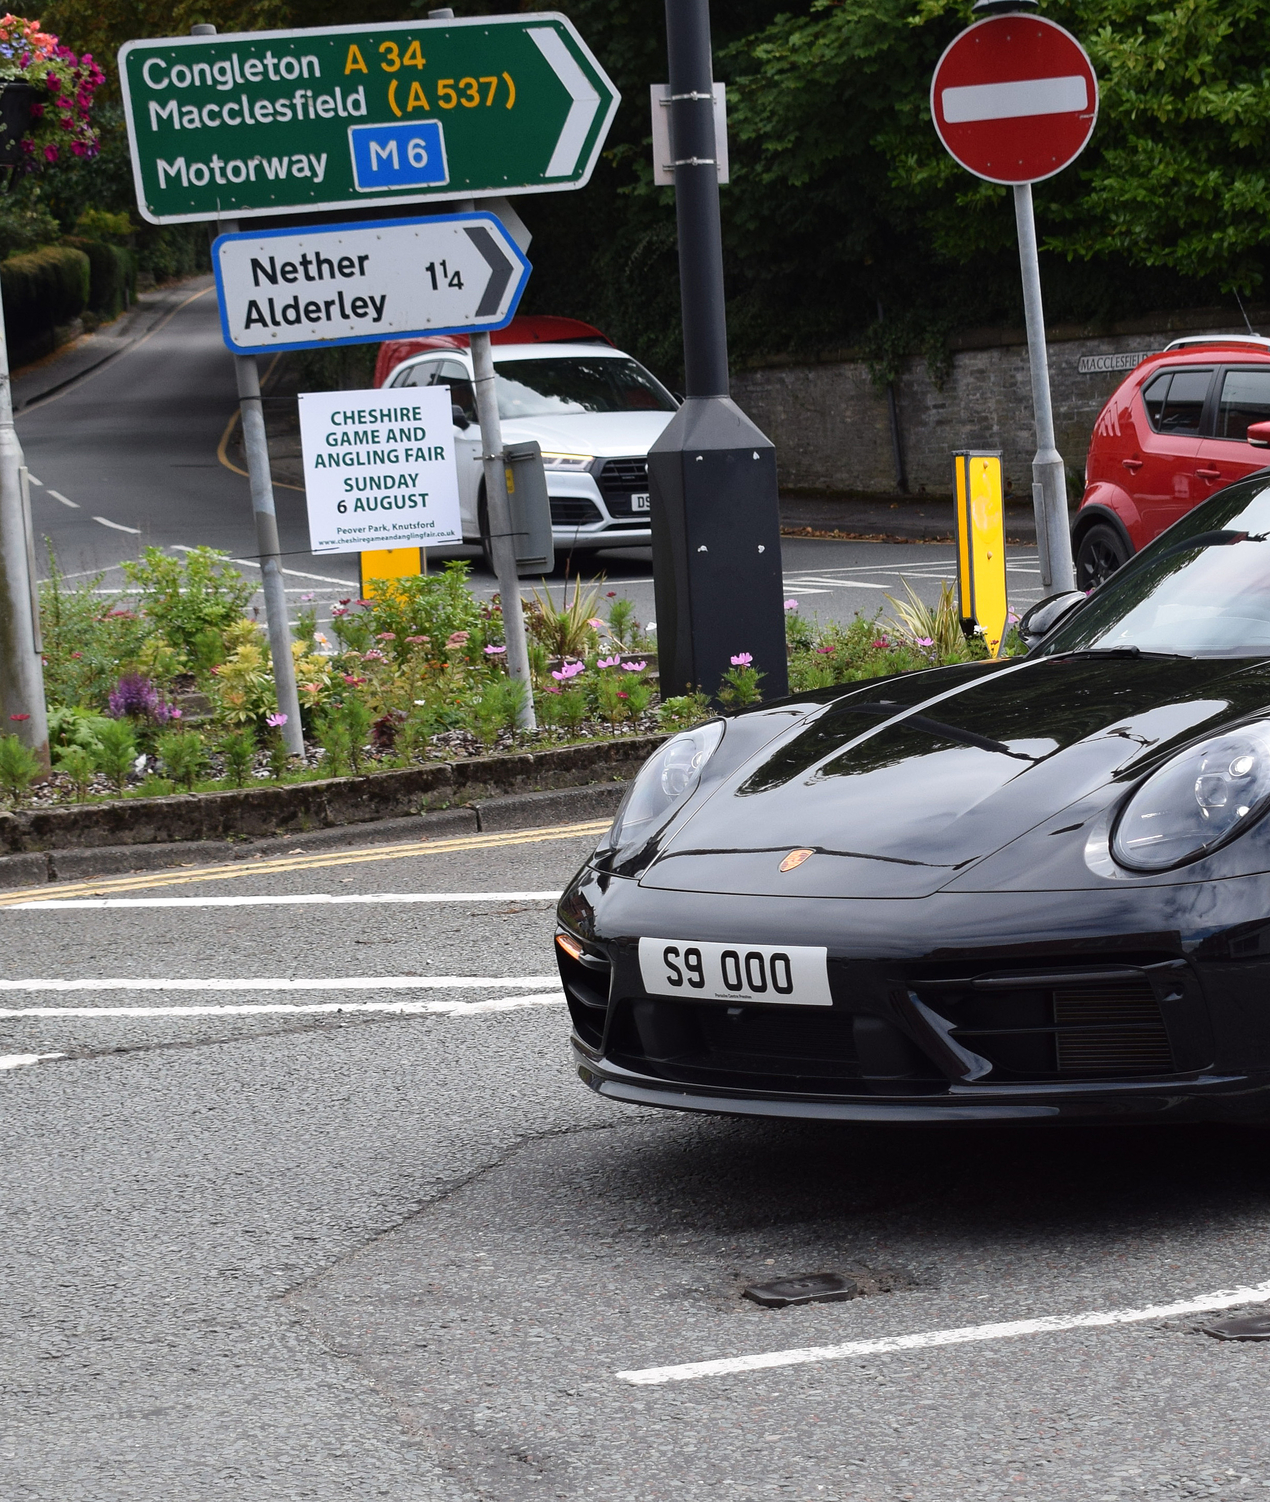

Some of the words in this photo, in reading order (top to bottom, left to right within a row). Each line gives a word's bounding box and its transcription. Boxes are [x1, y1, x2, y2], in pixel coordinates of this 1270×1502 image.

[143, 51, 320, 92] Congleton
[148, 85, 368, 132] Macclesfield
[156, 151, 328, 190] Motorway
[249, 251, 370, 288] Nether
[244, 291, 387, 331] Alderley
[330, 406, 422, 426] CHESHIRE
[325, 429, 381, 447] GAME
[386, 427, 426, 443] AND
[314, 449, 399, 469] ANGLING
[405, 446, 446, 463] FAIR
[343, 473, 419, 493] SUNDAY
[337, 500, 348, 514] 6
[353, 493, 429, 513] AUGUST
[318, 530, 456, 546] www.cheshiregameandanglingfair.co.uk
[337, 526, 366, 535] Peover
[368, 524, 390, 533] Park,
[392, 520, 435, 531] Knutsford
[663, 945, 706, 989] S9
